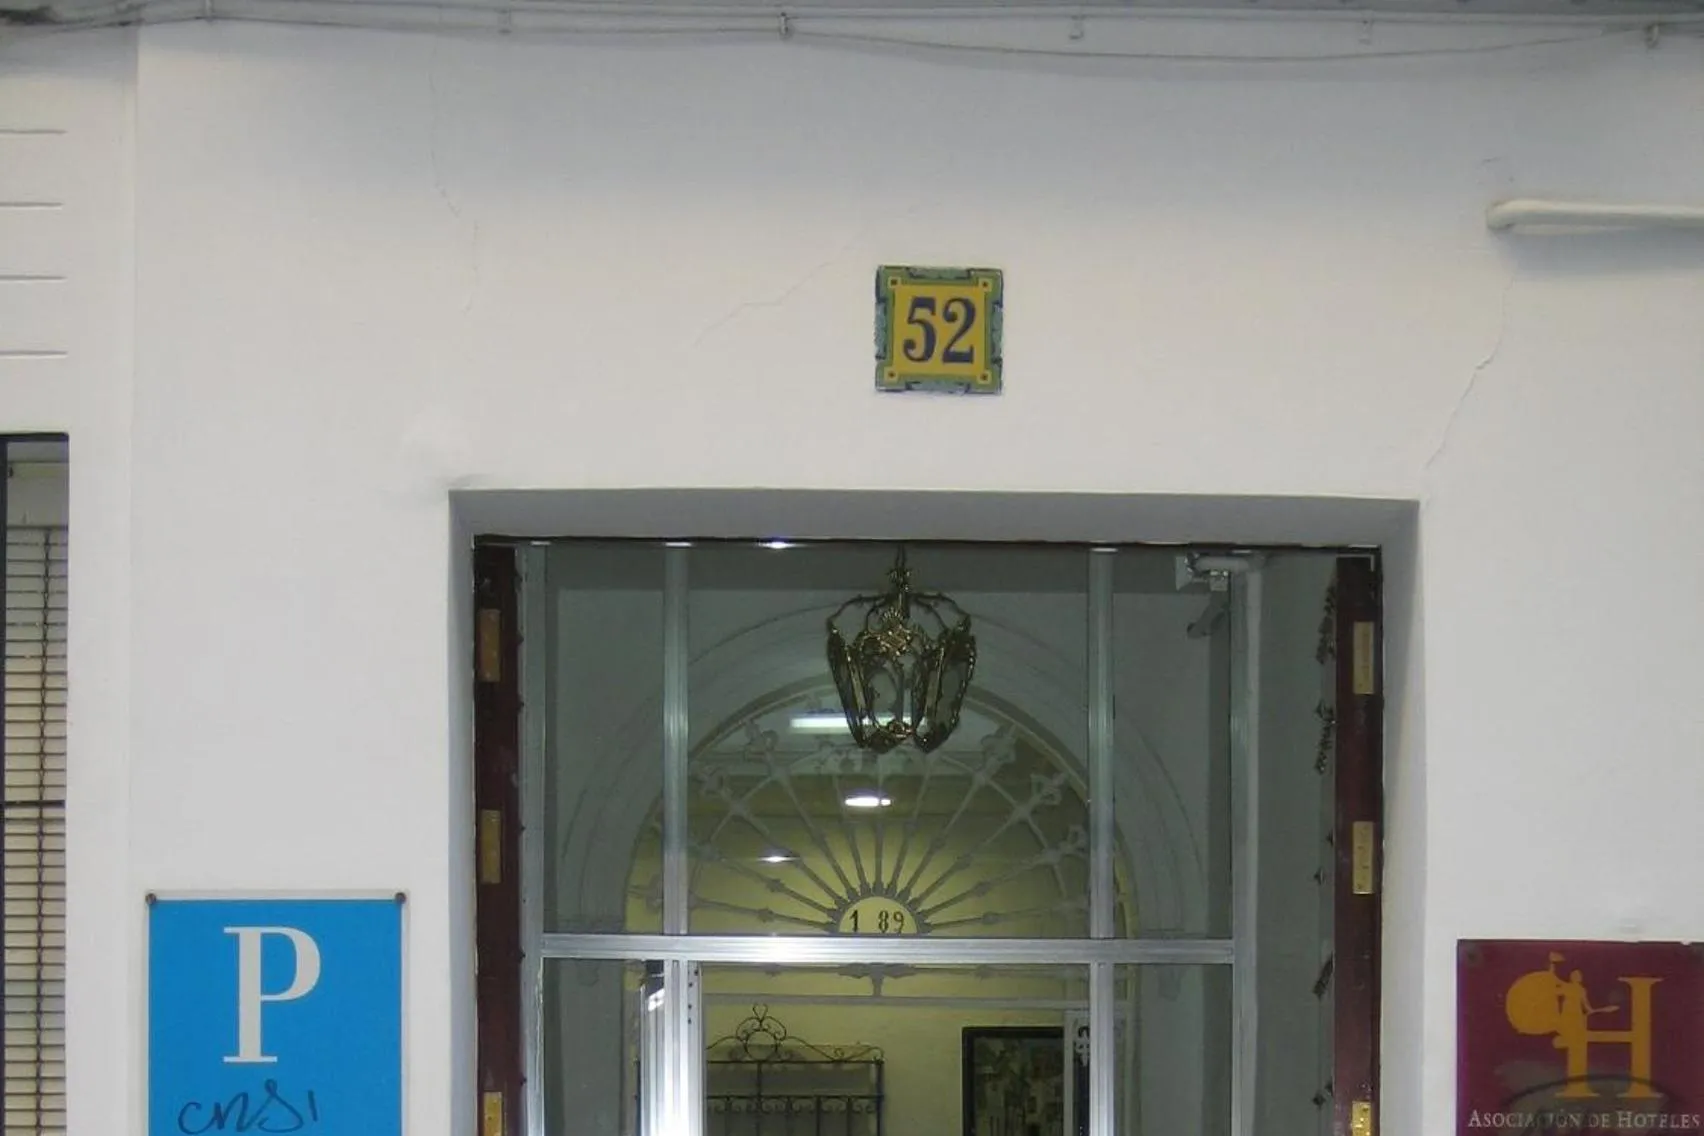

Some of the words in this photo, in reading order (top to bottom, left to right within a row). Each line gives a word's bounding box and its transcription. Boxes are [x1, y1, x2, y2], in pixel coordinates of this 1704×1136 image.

[903, 296, 976, 364] 52
[223, 926, 321, 1063] P
[1467, 1109, 1583, 1128] ASOCIAIÓN
[1588, 1112, 1611, 1128] DE
[1616, 1110, 1701, 1129] HOTELES
